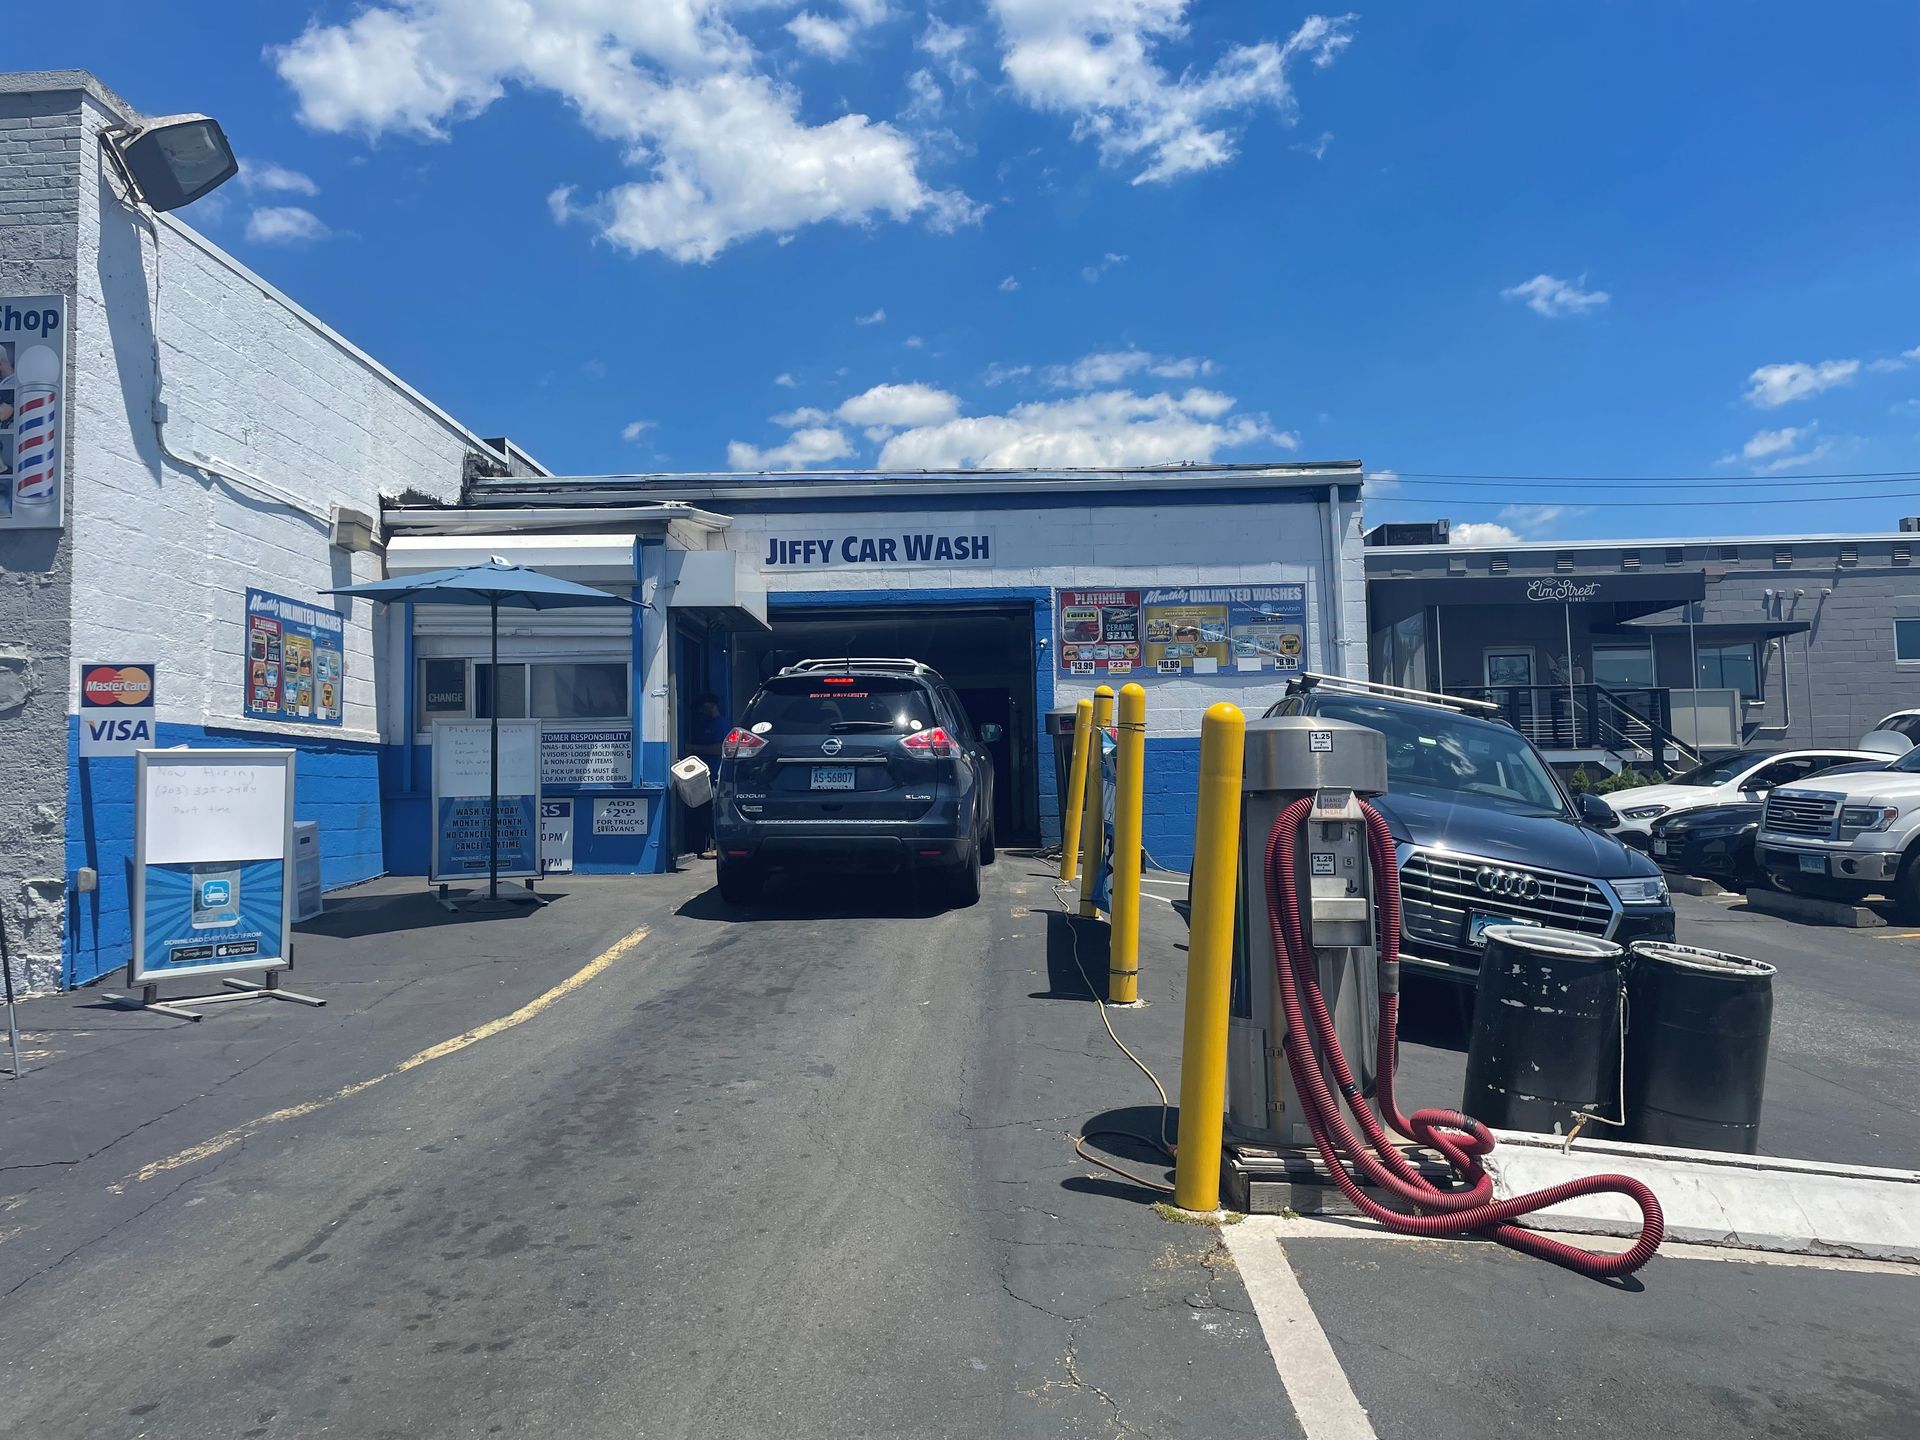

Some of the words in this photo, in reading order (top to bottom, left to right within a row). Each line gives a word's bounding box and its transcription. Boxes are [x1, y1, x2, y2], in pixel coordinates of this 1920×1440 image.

[0, 305, 59, 338] hop
[765, 538, 834, 565] JIFFY
[841, 536, 898, 562] CAR
[903, 534, 990, 561] WASH
[1527, 580, 1558, 601] Elm
[1556, 579, 1601, 598] Street
[1074, 593, 1127, 605] PLATINUM
[1143, 589, 1189, 604] Monthly
[1189, 588, 1252, 603] UNLIMITED
[1252, 587, 1302, 601] WASHES
[249, 594, 280, 617] Monthly
[279, 601, 316, 626] UNLIMITED
[1106, 623, 1135, 631] CERAMIC
[1106, 631, 1135, 640] SEAL
[1158, 660, 1180, 669] $10.99
[86, 681, 151, 692] MasterCard
[428, 693, 463, 703] CHANGE
[85, 720, 150, 741] VISA
[570, 733, 628, 741] RESPONSIBILITY
[591, 749, 625, 757] MOLDINGS
[203, 766, 256, 783] Hiring
[592, 766, 610, 774] MUST
[568, 774, 595, 782] OBJECTS
[456, 808, 479, 816] WASH
[452, 820, 480, 828] MONTH
[516, 829, 529, 837] FEE
[548, 832, 563, 842] PM
[455, 841, 484, 850] CANCEL
[548, 858, 563, 867] PM
[1313, 855, 1333, 863] $1.25
[1346, 858, 1352, 866] 5
